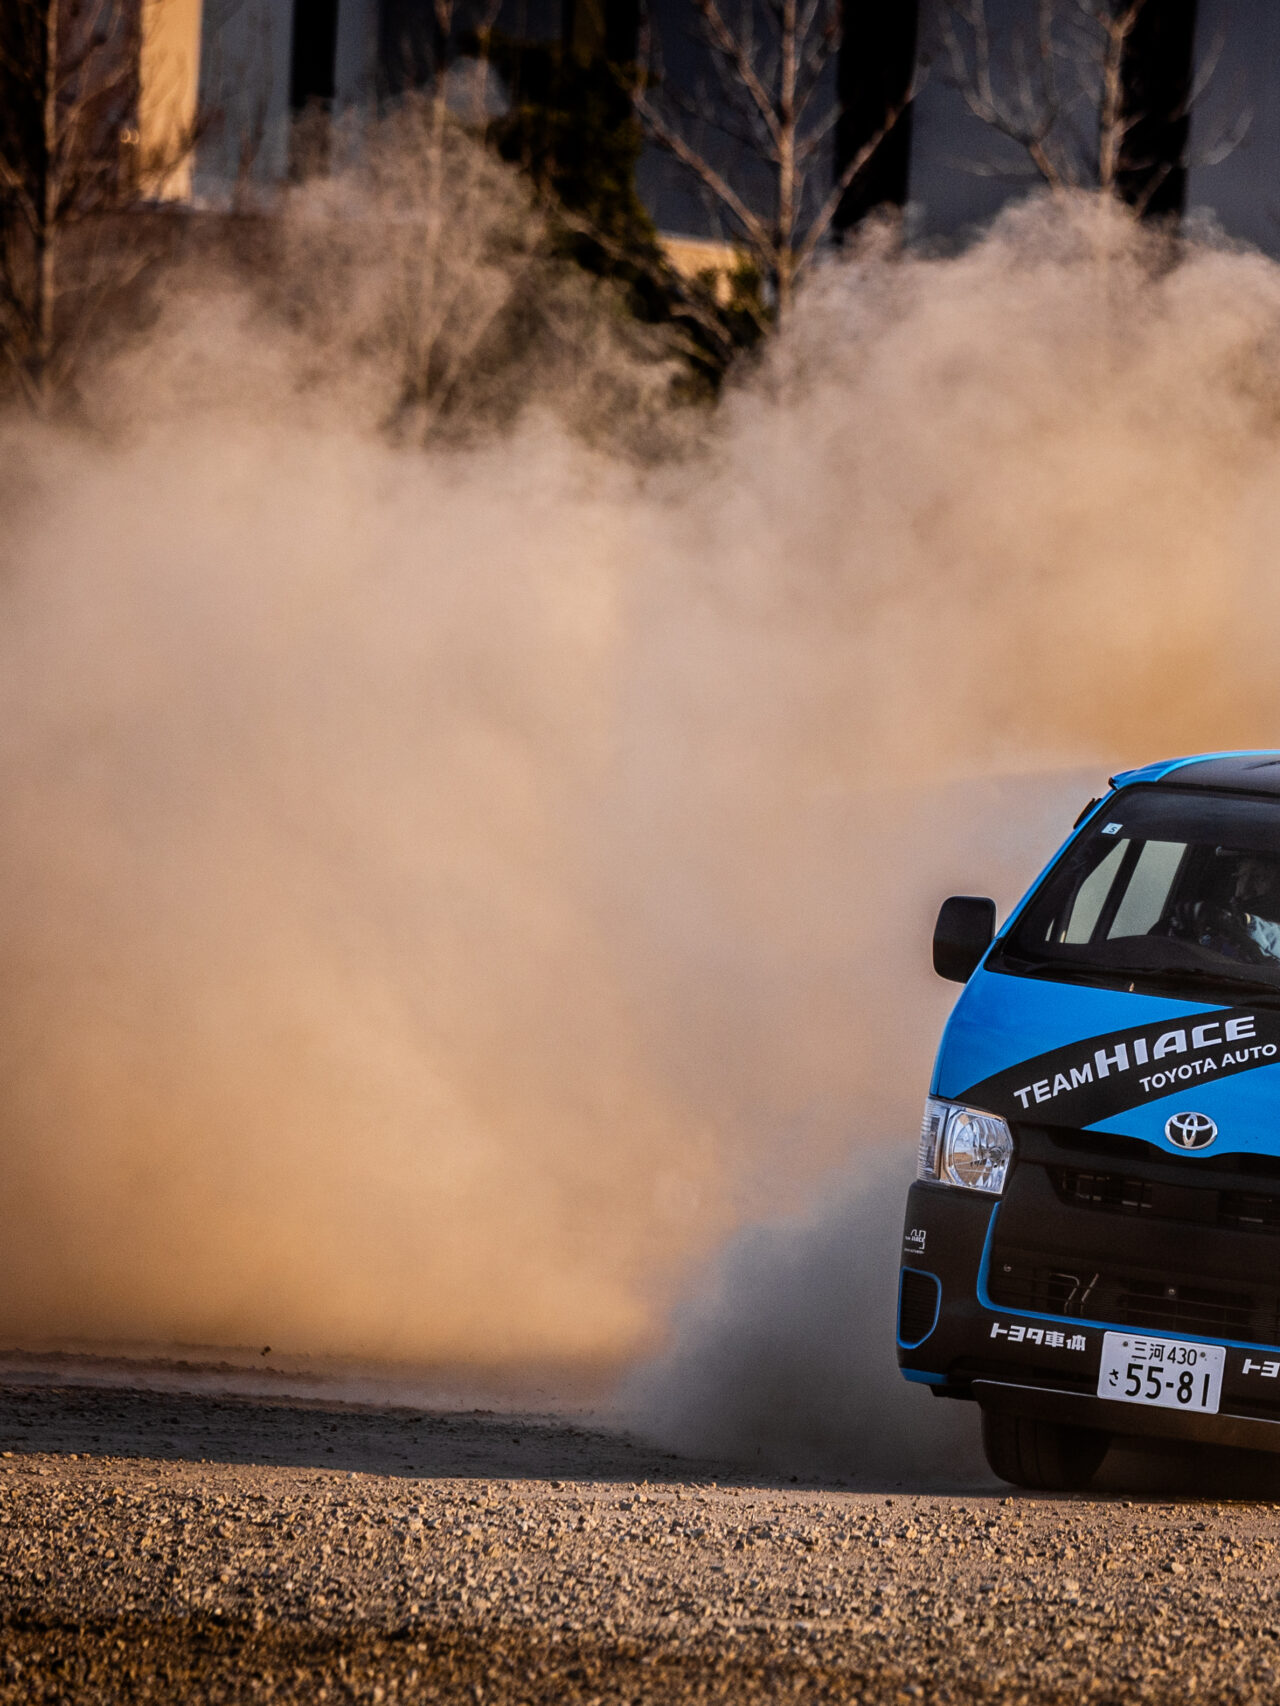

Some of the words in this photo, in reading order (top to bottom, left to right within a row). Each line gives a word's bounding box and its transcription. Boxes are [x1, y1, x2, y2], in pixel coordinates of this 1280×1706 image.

[1013, 1063, 1093, 1109] TEAM
[1094, 1016, 1256, 1078] HIACE
[1139, 1060, 1217, 1092] TOYOTA
[1221, 1044, 1277, 1067] AUTO
[990, 1322, 1086, 1351] トヨタ車体
[1108, 1368, 1120, 1387] さ
[1124, 1362, 1211, 1407] 55-81
